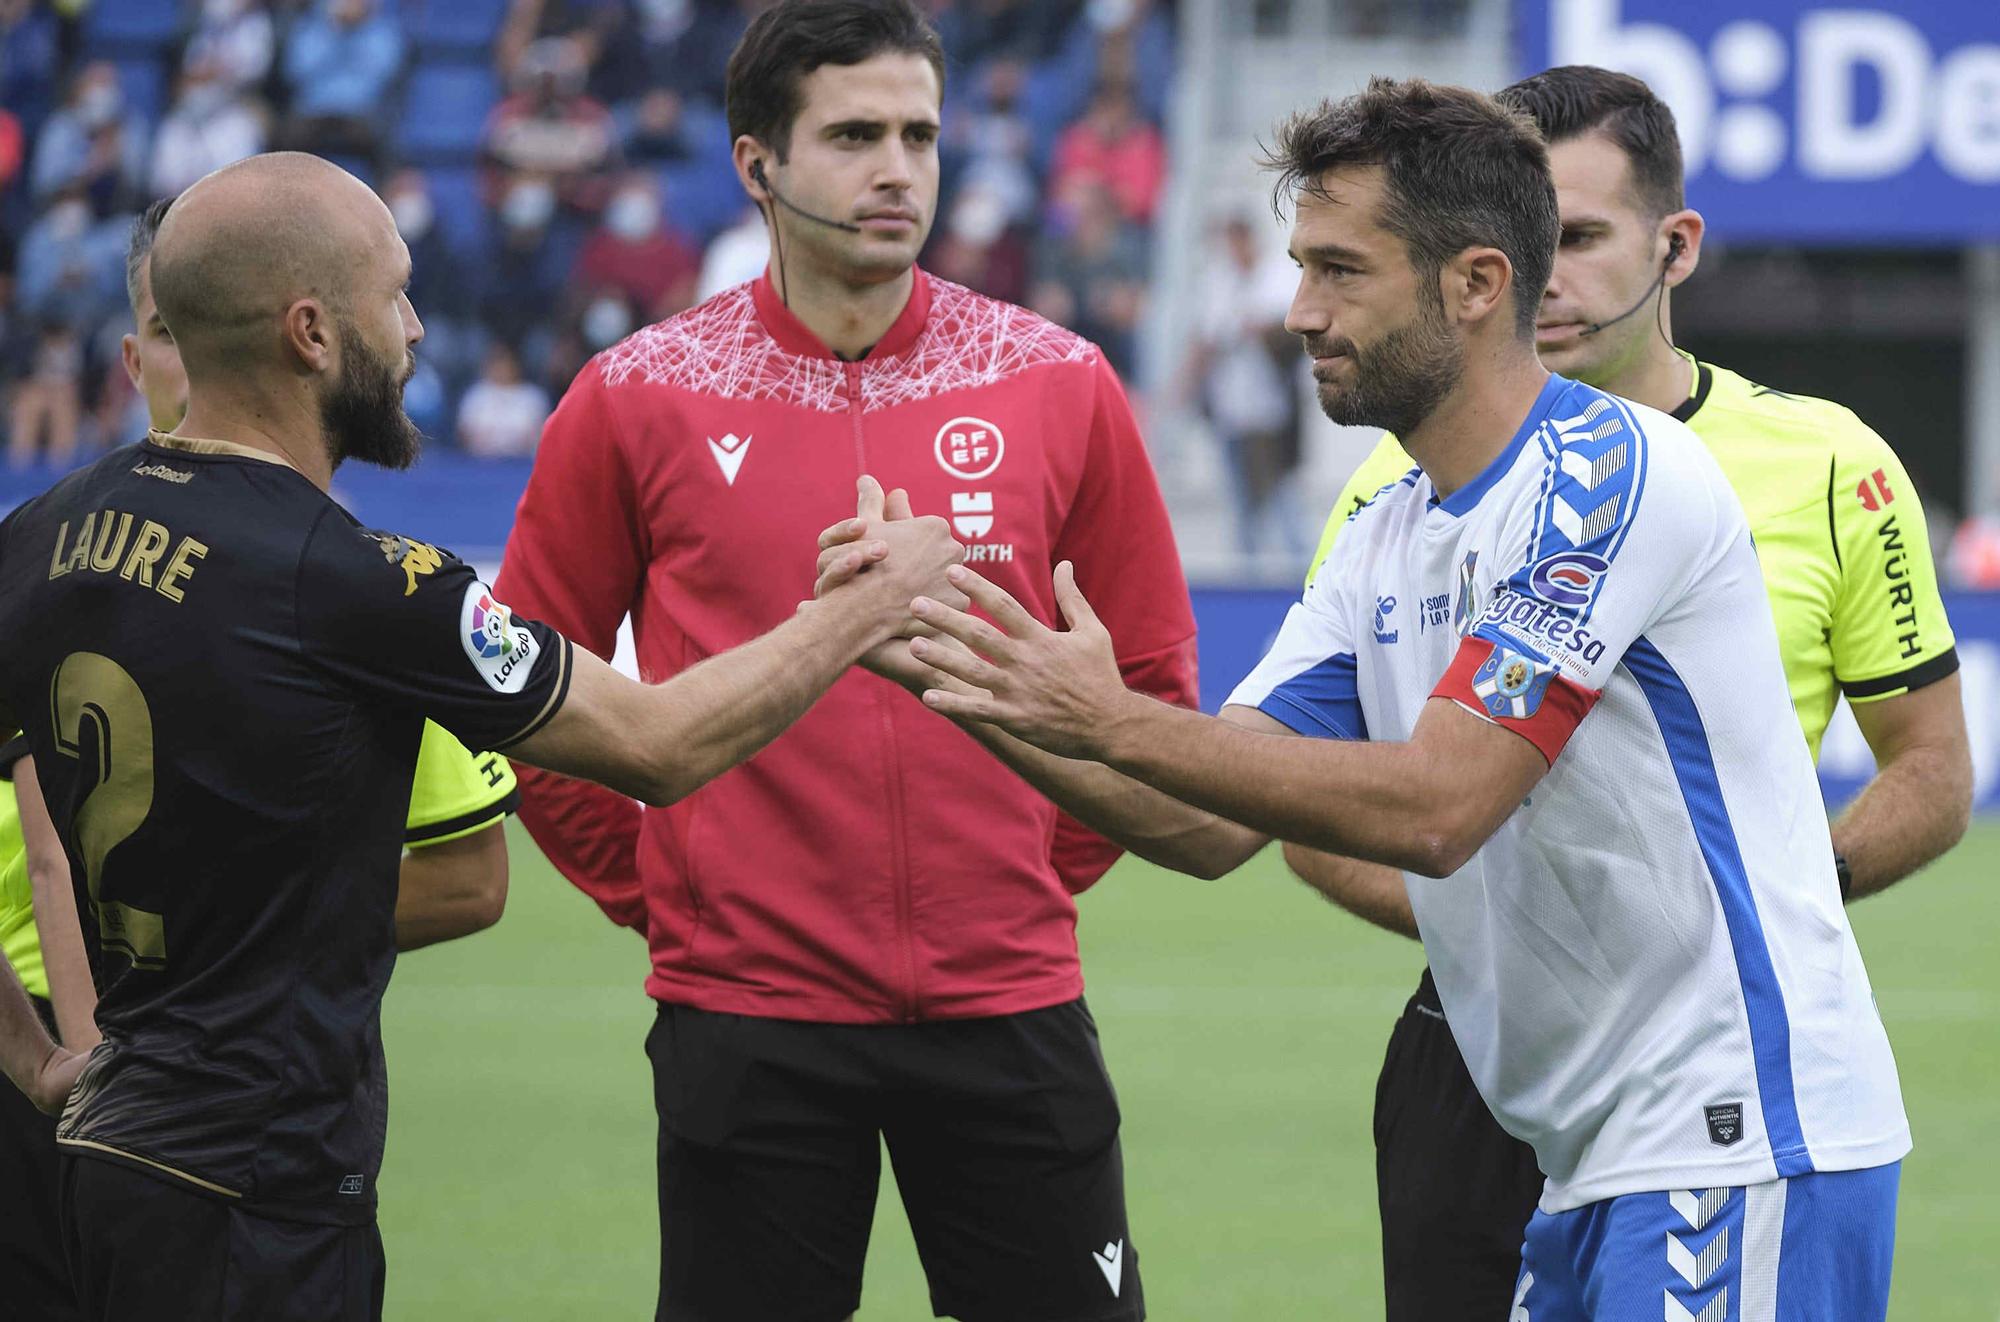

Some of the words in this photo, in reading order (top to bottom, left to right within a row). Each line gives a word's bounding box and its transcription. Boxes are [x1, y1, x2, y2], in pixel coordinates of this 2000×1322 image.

[48, 509, 209, 604] LAURE
[1878, 514, 1922, 660] WÜRTH
[1429, 611, 1443, 626] LA
[1532, 637, 1546, 650] de
[51, 650, 167, 972] 2
